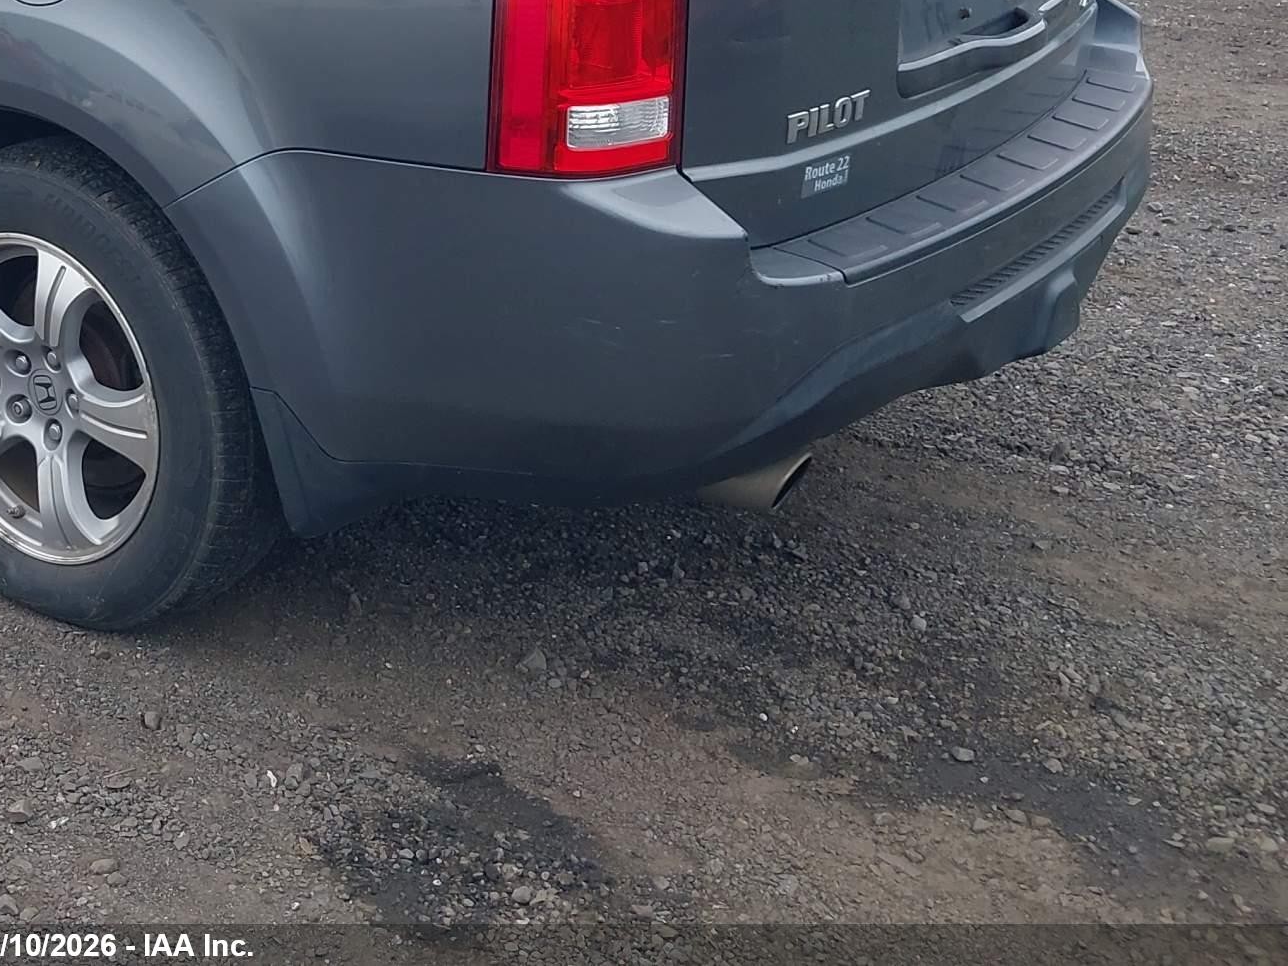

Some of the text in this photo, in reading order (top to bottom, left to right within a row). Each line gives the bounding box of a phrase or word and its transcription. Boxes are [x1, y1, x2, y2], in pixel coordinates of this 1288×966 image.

[786, 89, 871, 144] PILOT
[804, 155, 850, 181] Route 22
